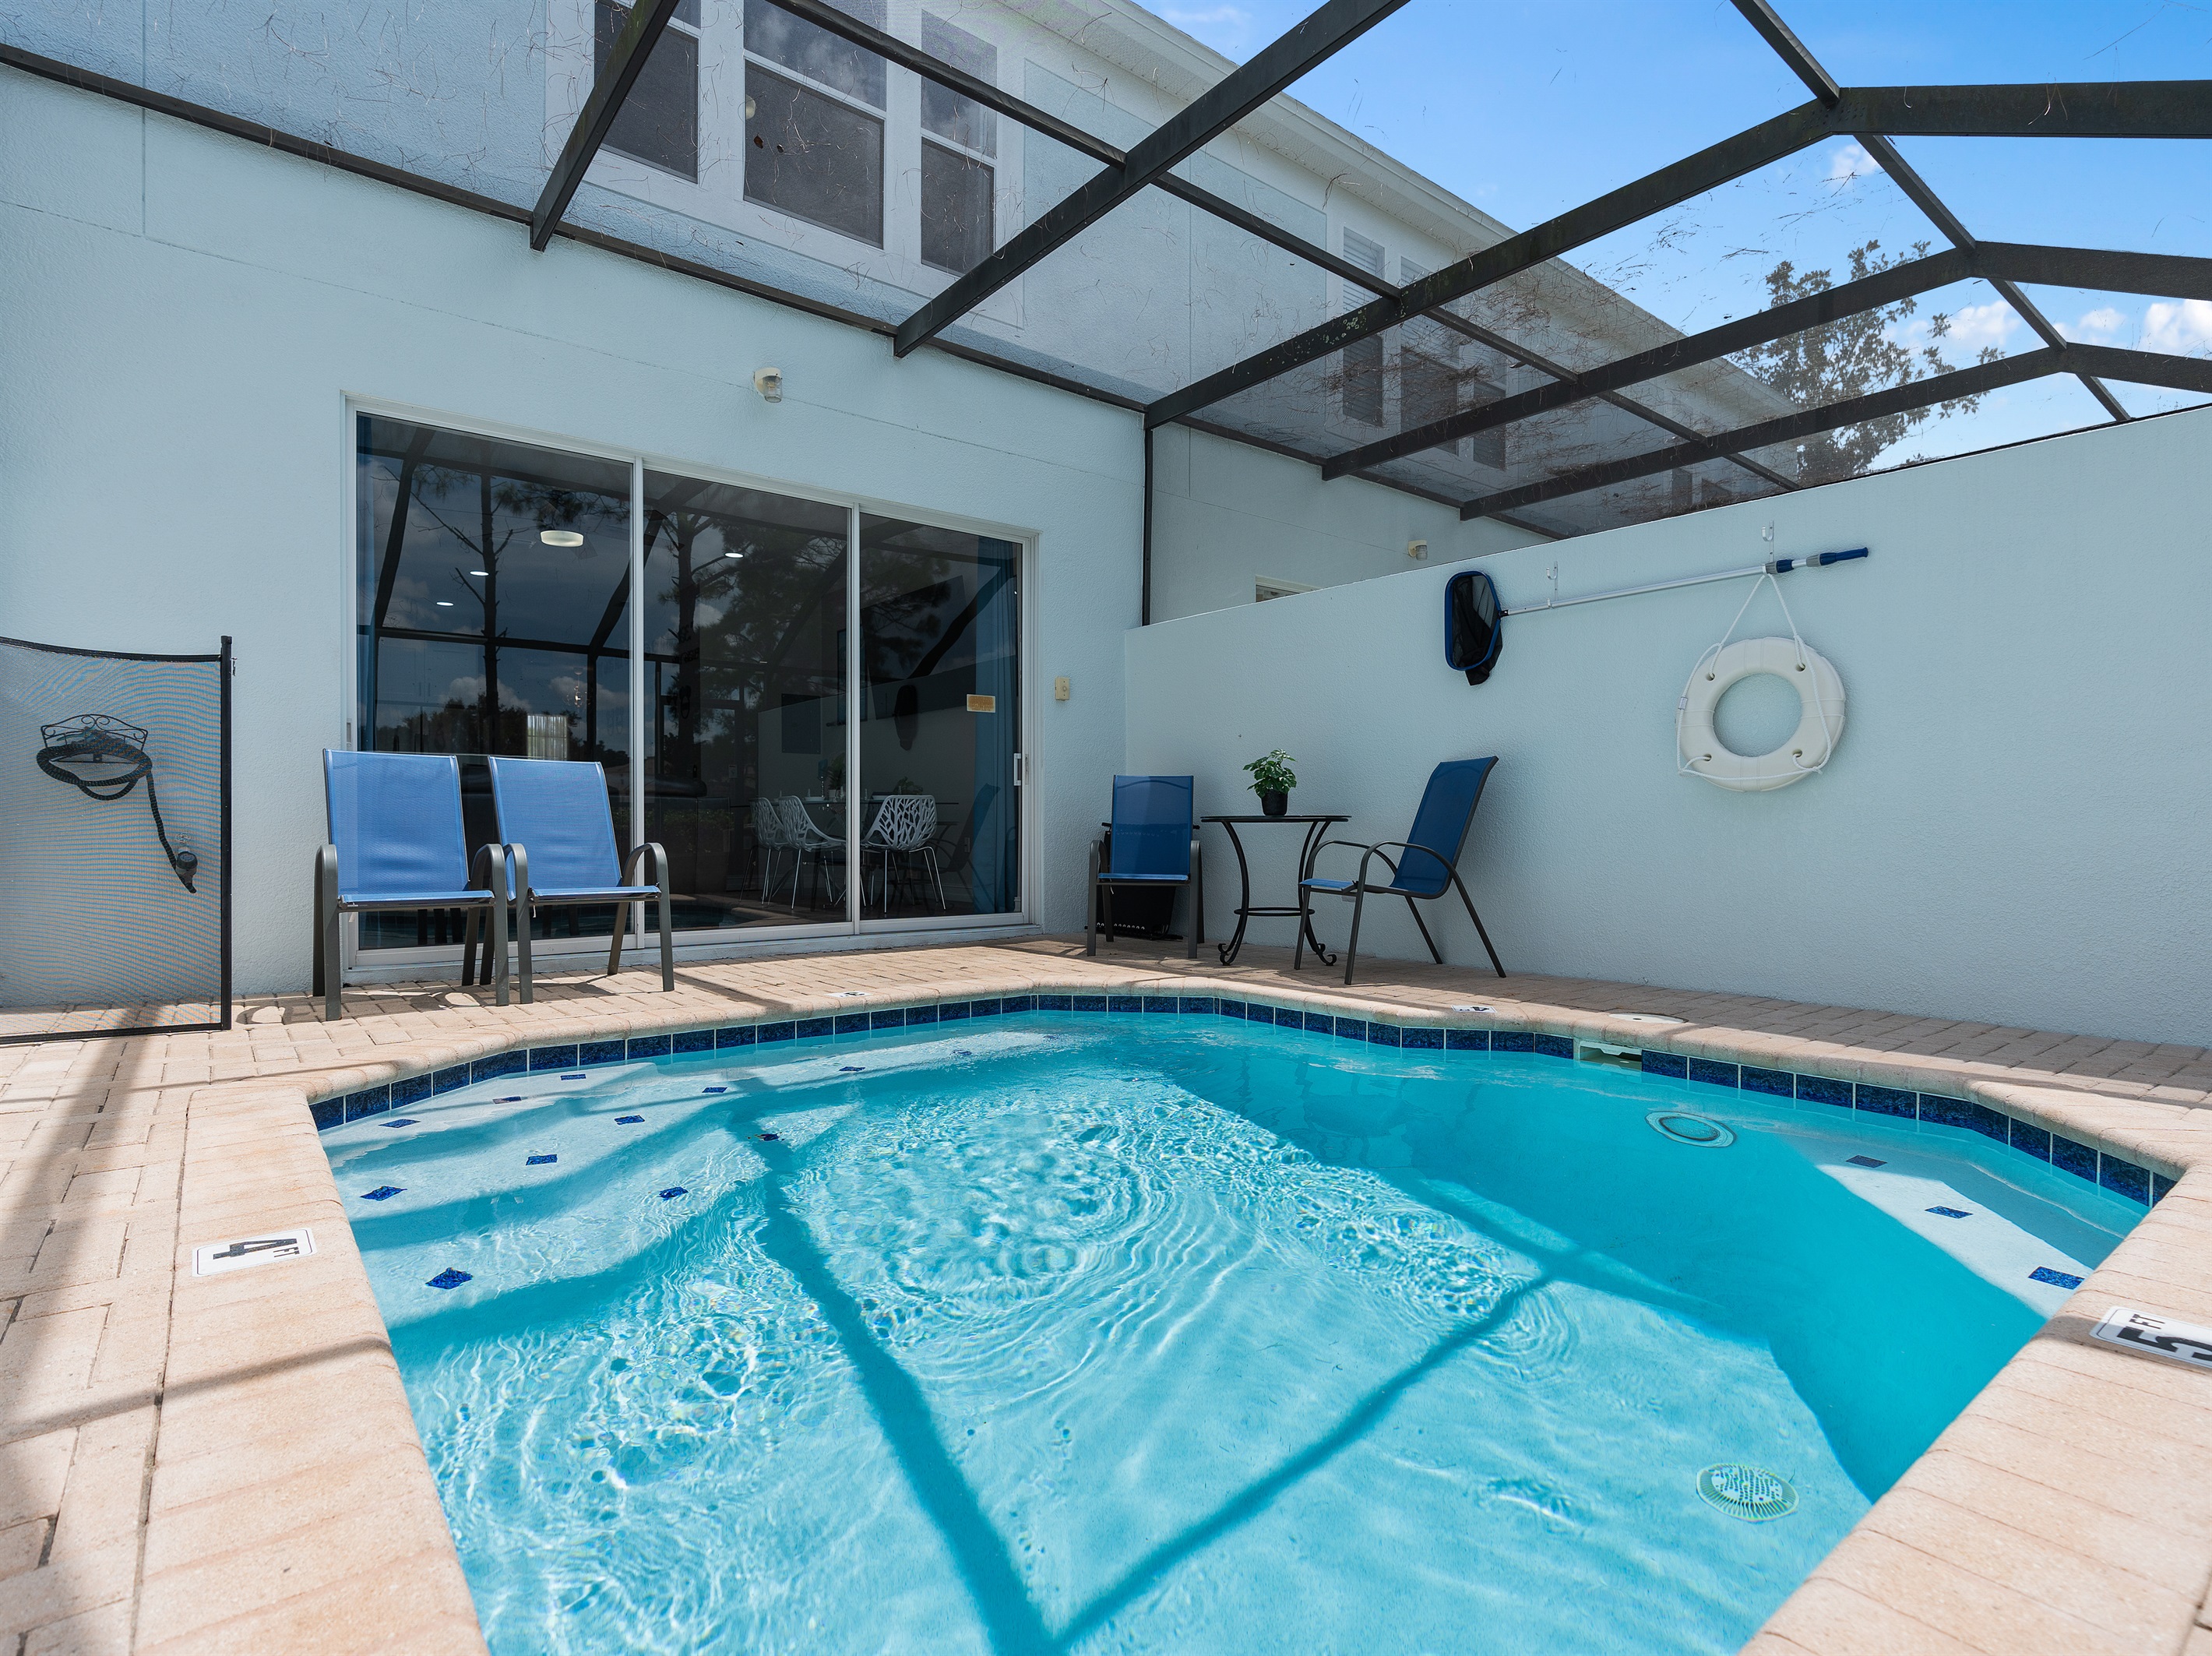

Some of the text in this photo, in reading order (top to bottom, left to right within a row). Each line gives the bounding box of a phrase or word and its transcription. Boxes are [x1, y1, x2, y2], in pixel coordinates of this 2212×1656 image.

[213, 1238, 300, 1260] 4 FT
[2116, 1313, 2212, 1362] 5 FT
